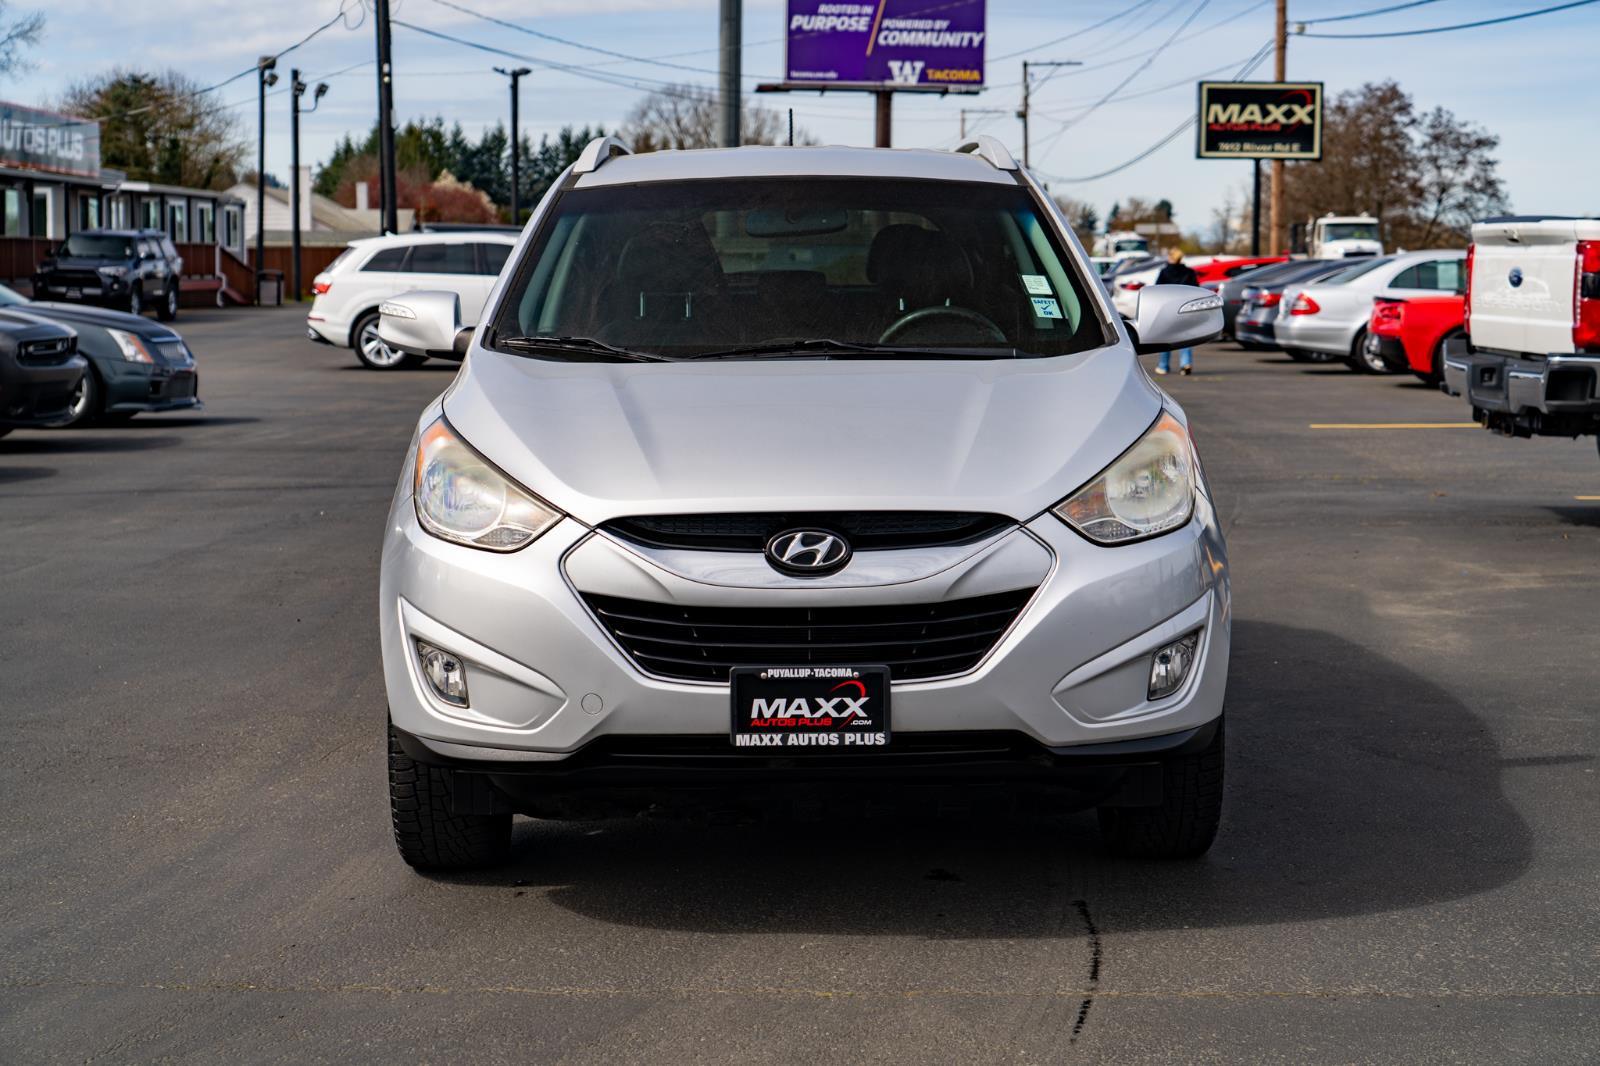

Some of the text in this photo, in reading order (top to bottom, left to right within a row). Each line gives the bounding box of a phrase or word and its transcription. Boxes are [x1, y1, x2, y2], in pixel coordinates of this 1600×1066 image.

[818, 4, 875, 14] ROOTED IN
[791, 14, 871, 31] PURPOSE
[881, 19, 950, 30] POWERED BY
[878, 31, 985, 48] COMMUNITY
[926, 69, 981, 81] TACOMA
[1208, 103, 1315, 125] MAXX
[47, 127, 83, 161] PLUS
[751, 697, 870, 718] MAXX
[751, 717, 832, 727] AUTOS PLUS
[735, 732, 886, 747] MAXX AUTOS PLUS
